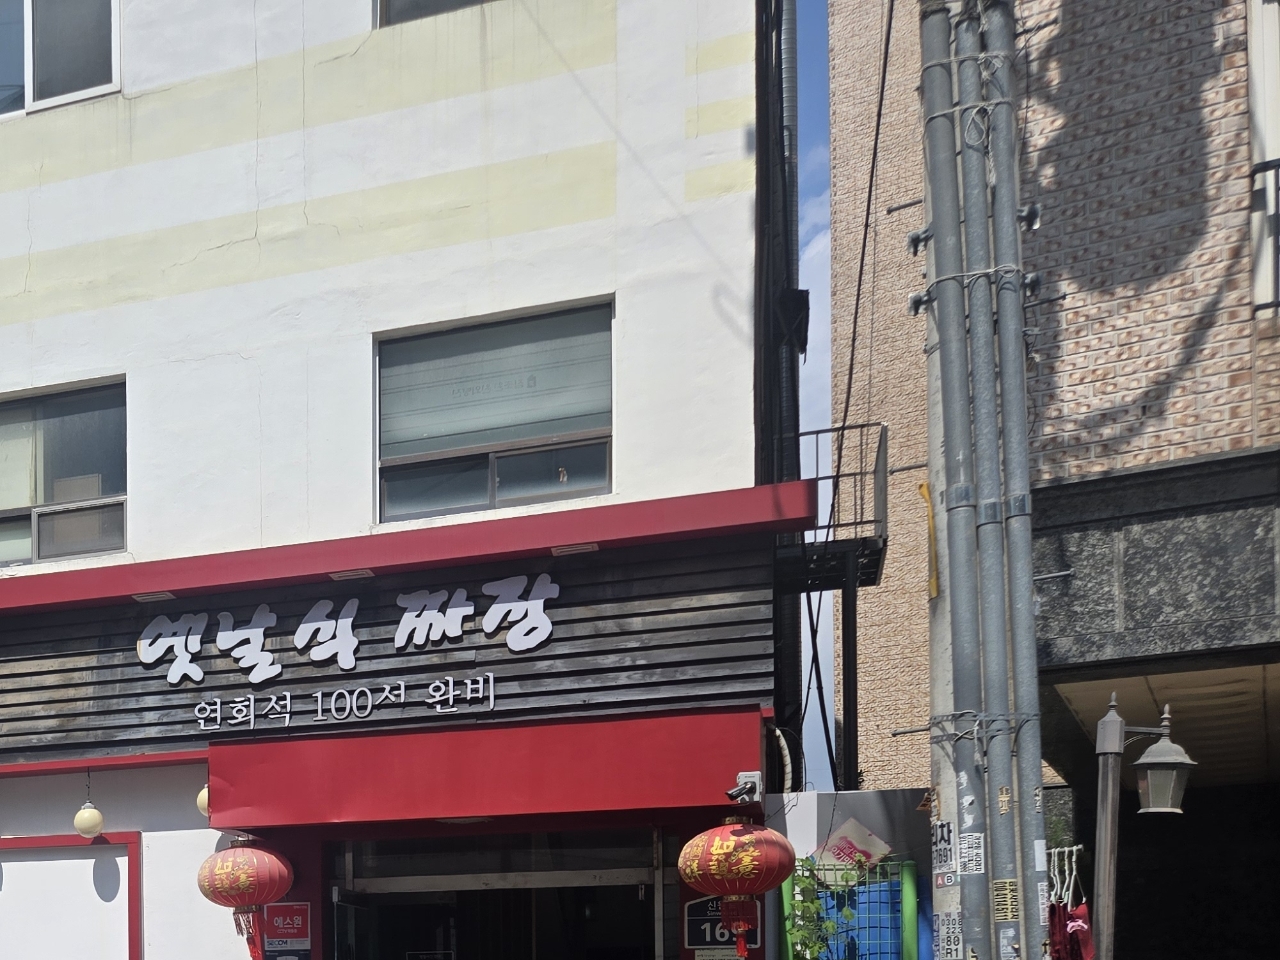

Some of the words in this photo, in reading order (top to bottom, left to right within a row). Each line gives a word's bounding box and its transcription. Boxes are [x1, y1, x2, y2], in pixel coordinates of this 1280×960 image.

[394, 572, 560, 652] 짜장
[193, 691, 293, 730] 연회석
[425, 672, 496, 714] 완비
[273, 916, 302, 928] 에스원
[945, 947, 959, 959] R1
